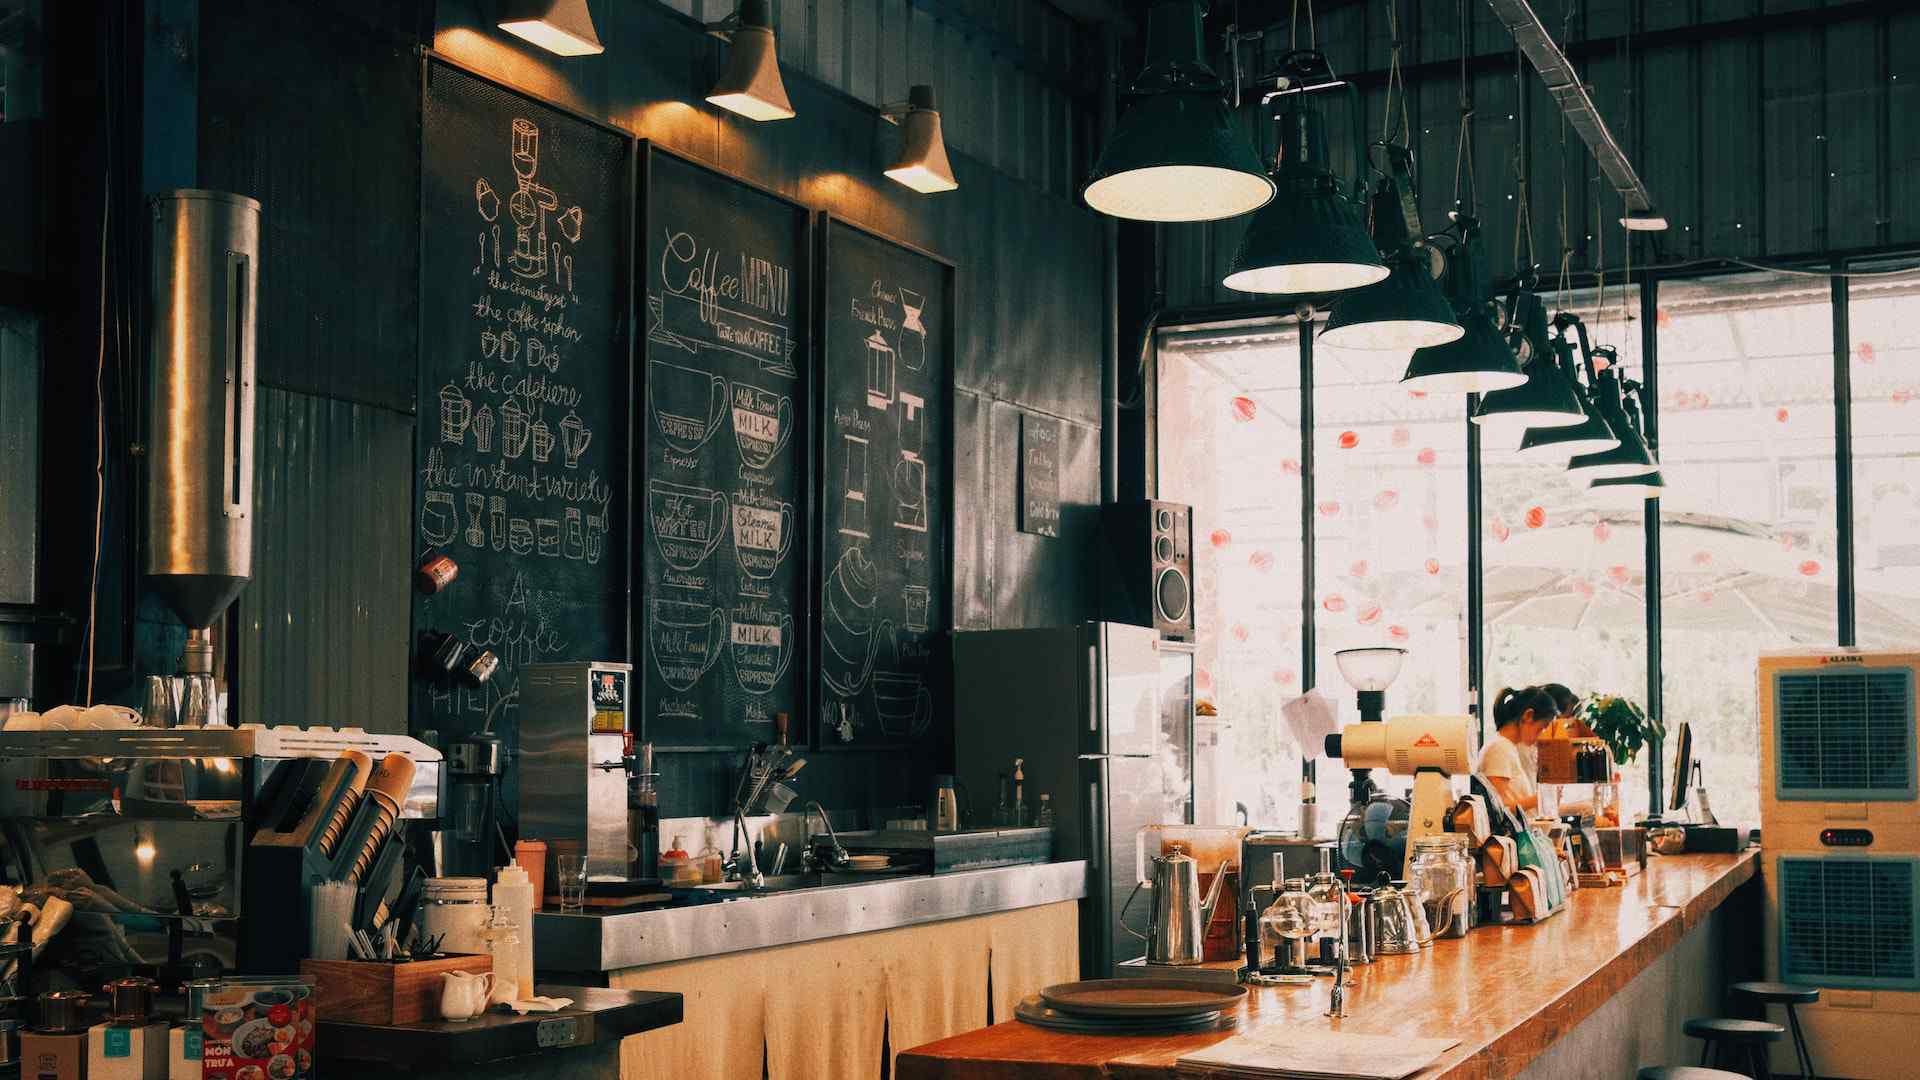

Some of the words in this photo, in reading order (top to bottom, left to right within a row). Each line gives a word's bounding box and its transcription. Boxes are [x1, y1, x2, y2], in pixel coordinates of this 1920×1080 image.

[661, 224, 739, 325] Coffee
[741, 251, 789, 317] MENU
[472, 295, 503, 321] the
[749, 327, 782, 355] COFFEE
[464, 360, 499, 393] the
[660, 418, 705, 441] ESPRESSO
[738, 413, 774, 437] MILK
[423, 447, 462, 487] the
[463, 458, 544, 501] instant
[543, 470, 613, 533] variety
[655, 515, 706, 540] WATER
[740, 529, 774, 549] MILK
[505, 570, 527, 615] A
[463, 616, 568, 672] coffee
[737, 626, 770, 643] MILK
